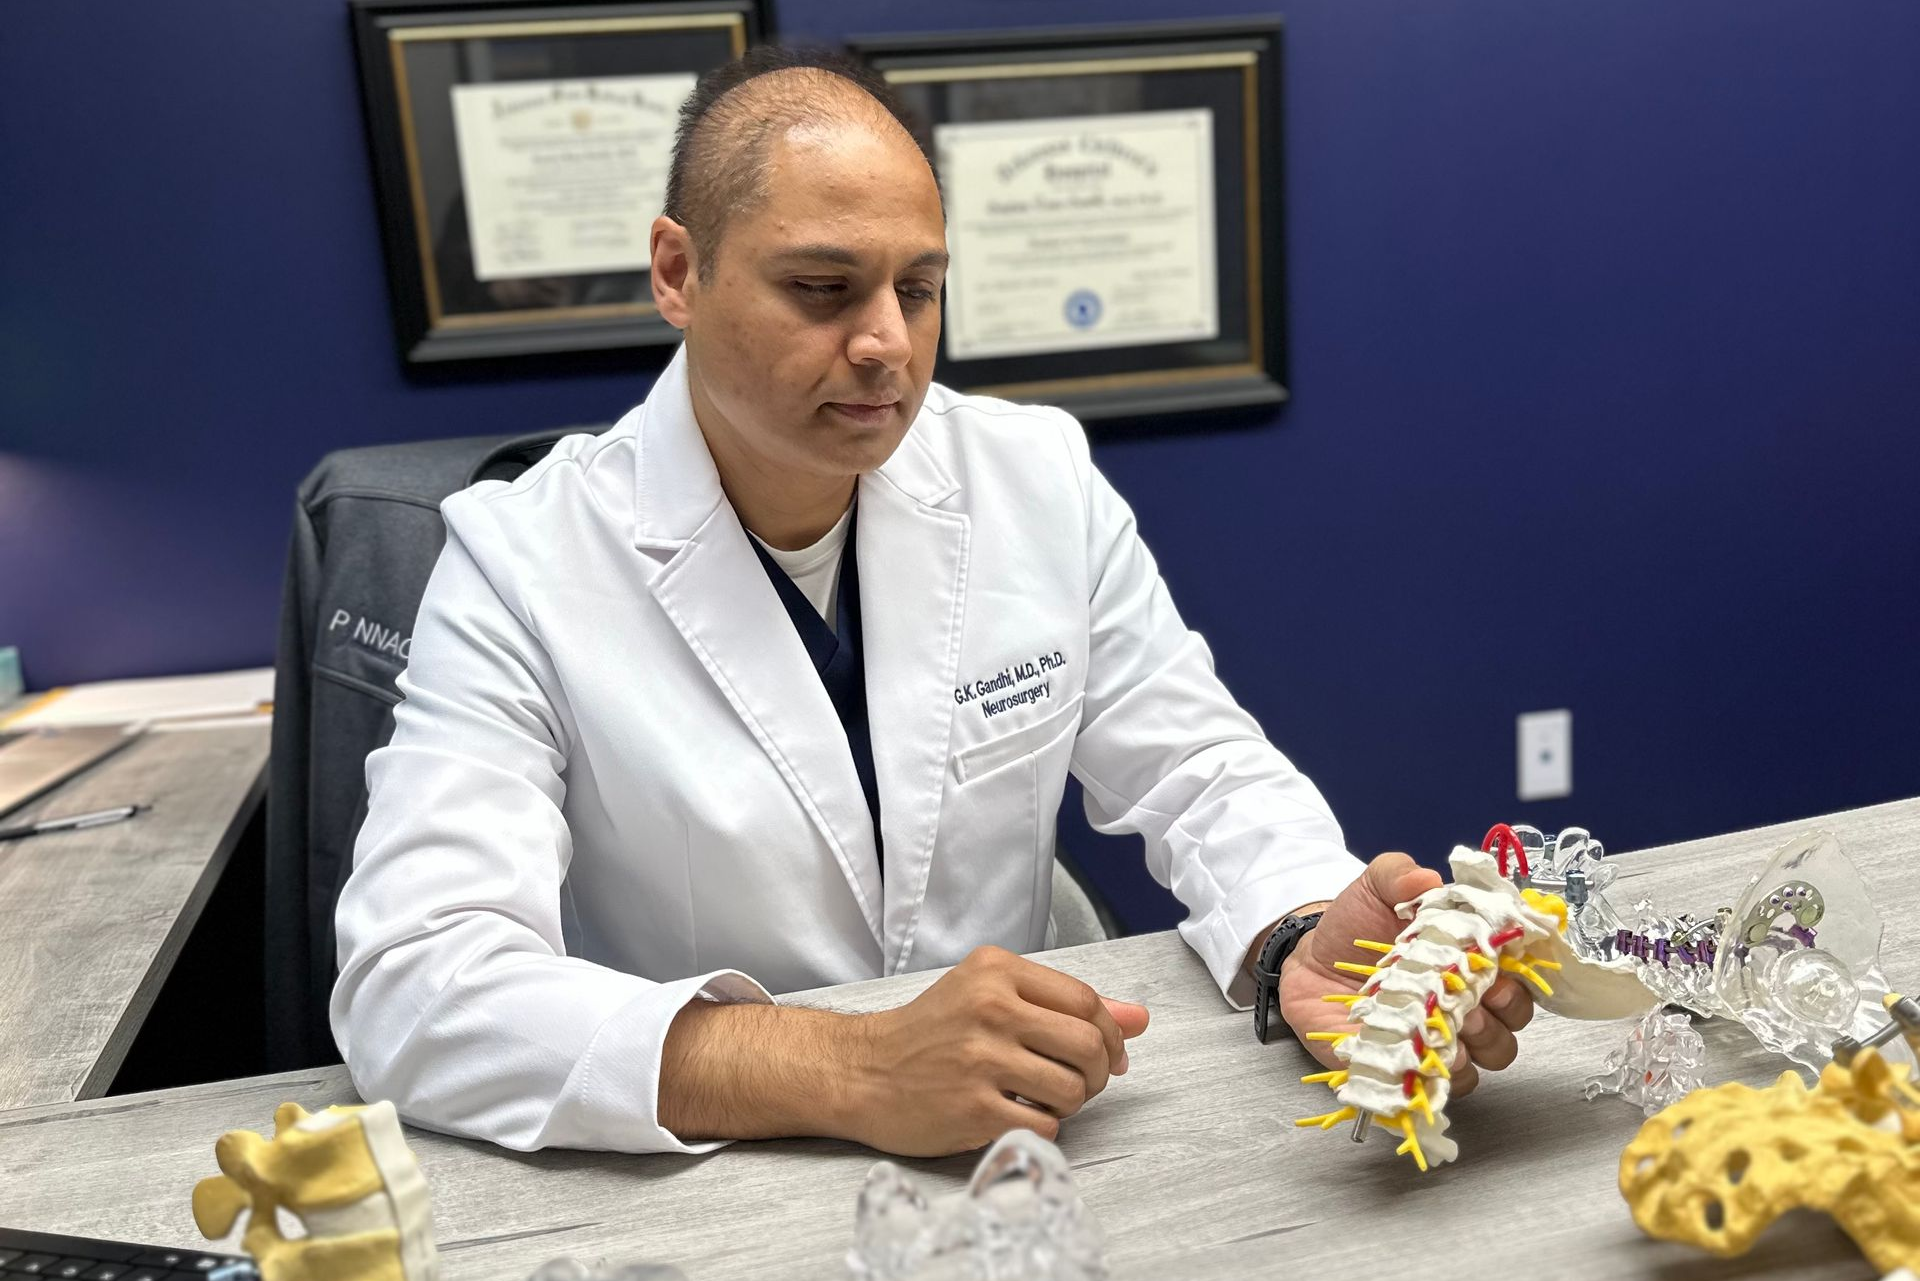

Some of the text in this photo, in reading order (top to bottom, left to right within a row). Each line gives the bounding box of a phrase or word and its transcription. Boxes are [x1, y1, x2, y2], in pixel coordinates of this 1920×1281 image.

[954, 651, 1066, 705] G.K. Gandhi, M.D., Ph.D.
[981, 681, 1050, 718] Neurosurgery
